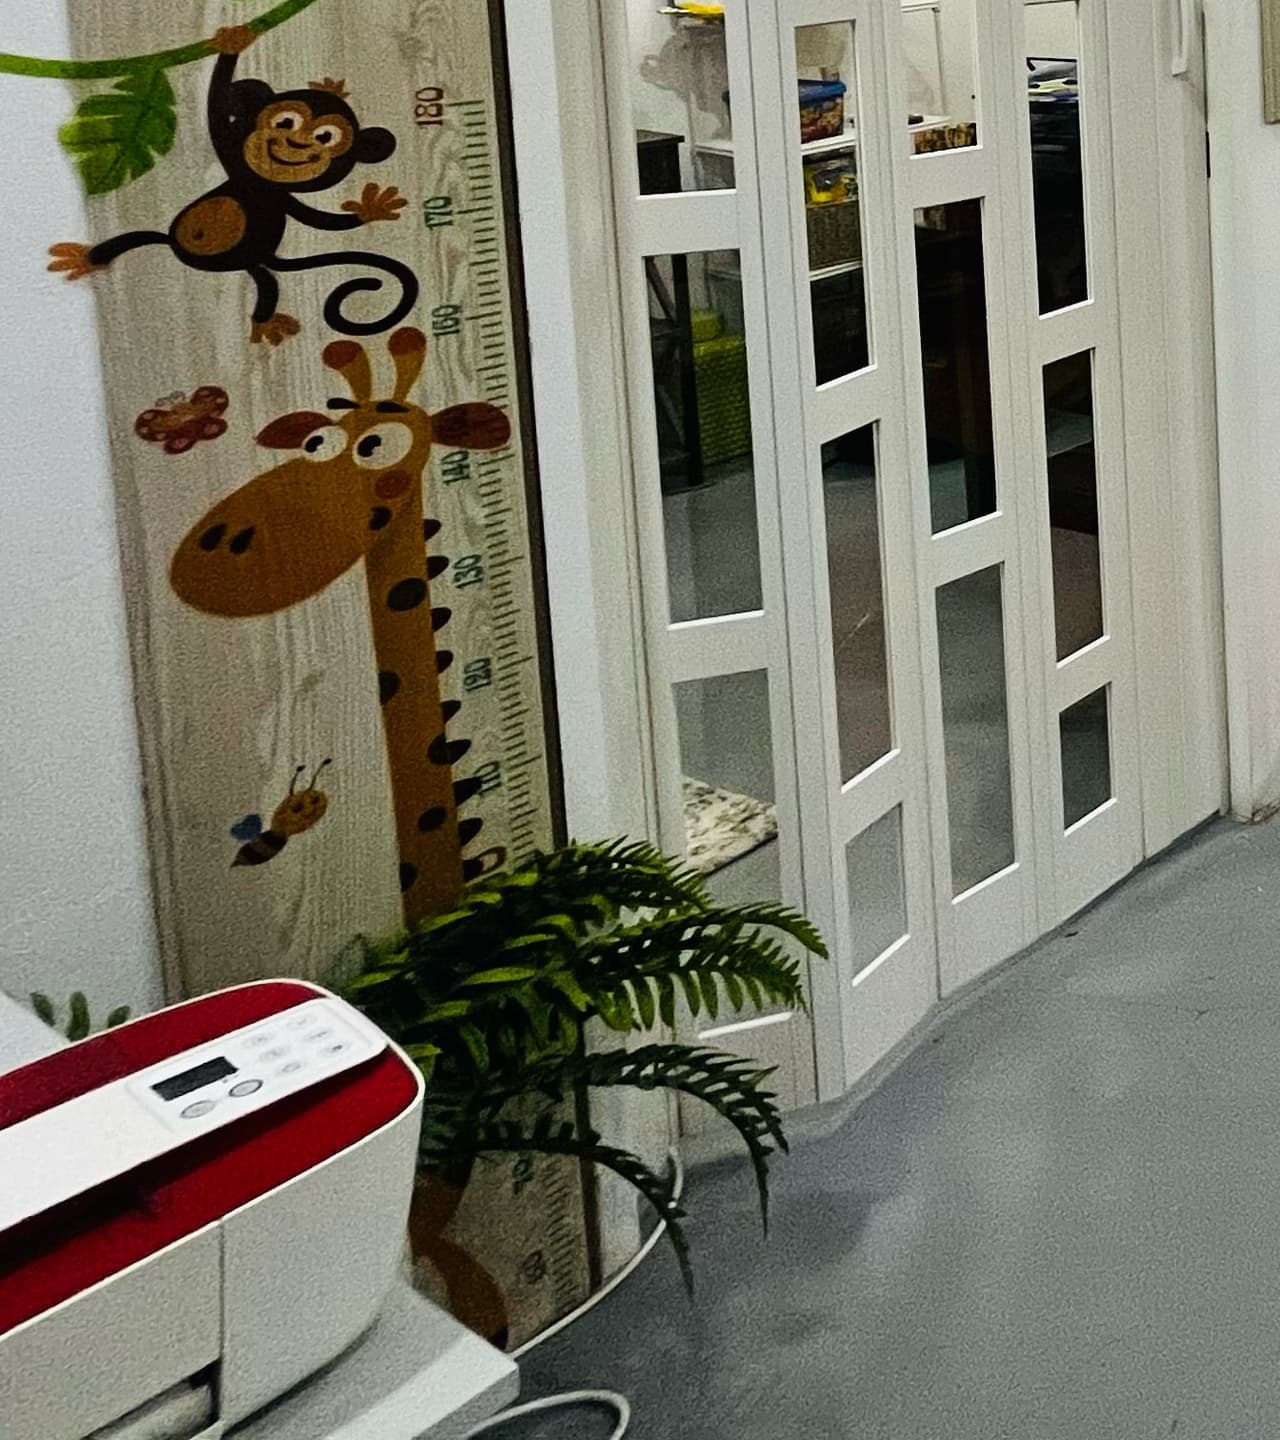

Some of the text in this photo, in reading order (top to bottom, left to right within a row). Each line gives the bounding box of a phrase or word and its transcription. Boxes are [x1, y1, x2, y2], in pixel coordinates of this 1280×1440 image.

[415, 86, 444, 127] 180
[424, 196, 453, 231] 170
[432, 304, 460, 338] 160
[453, 553, 484, 590] 130
[464, 657, 492, 693] 120
